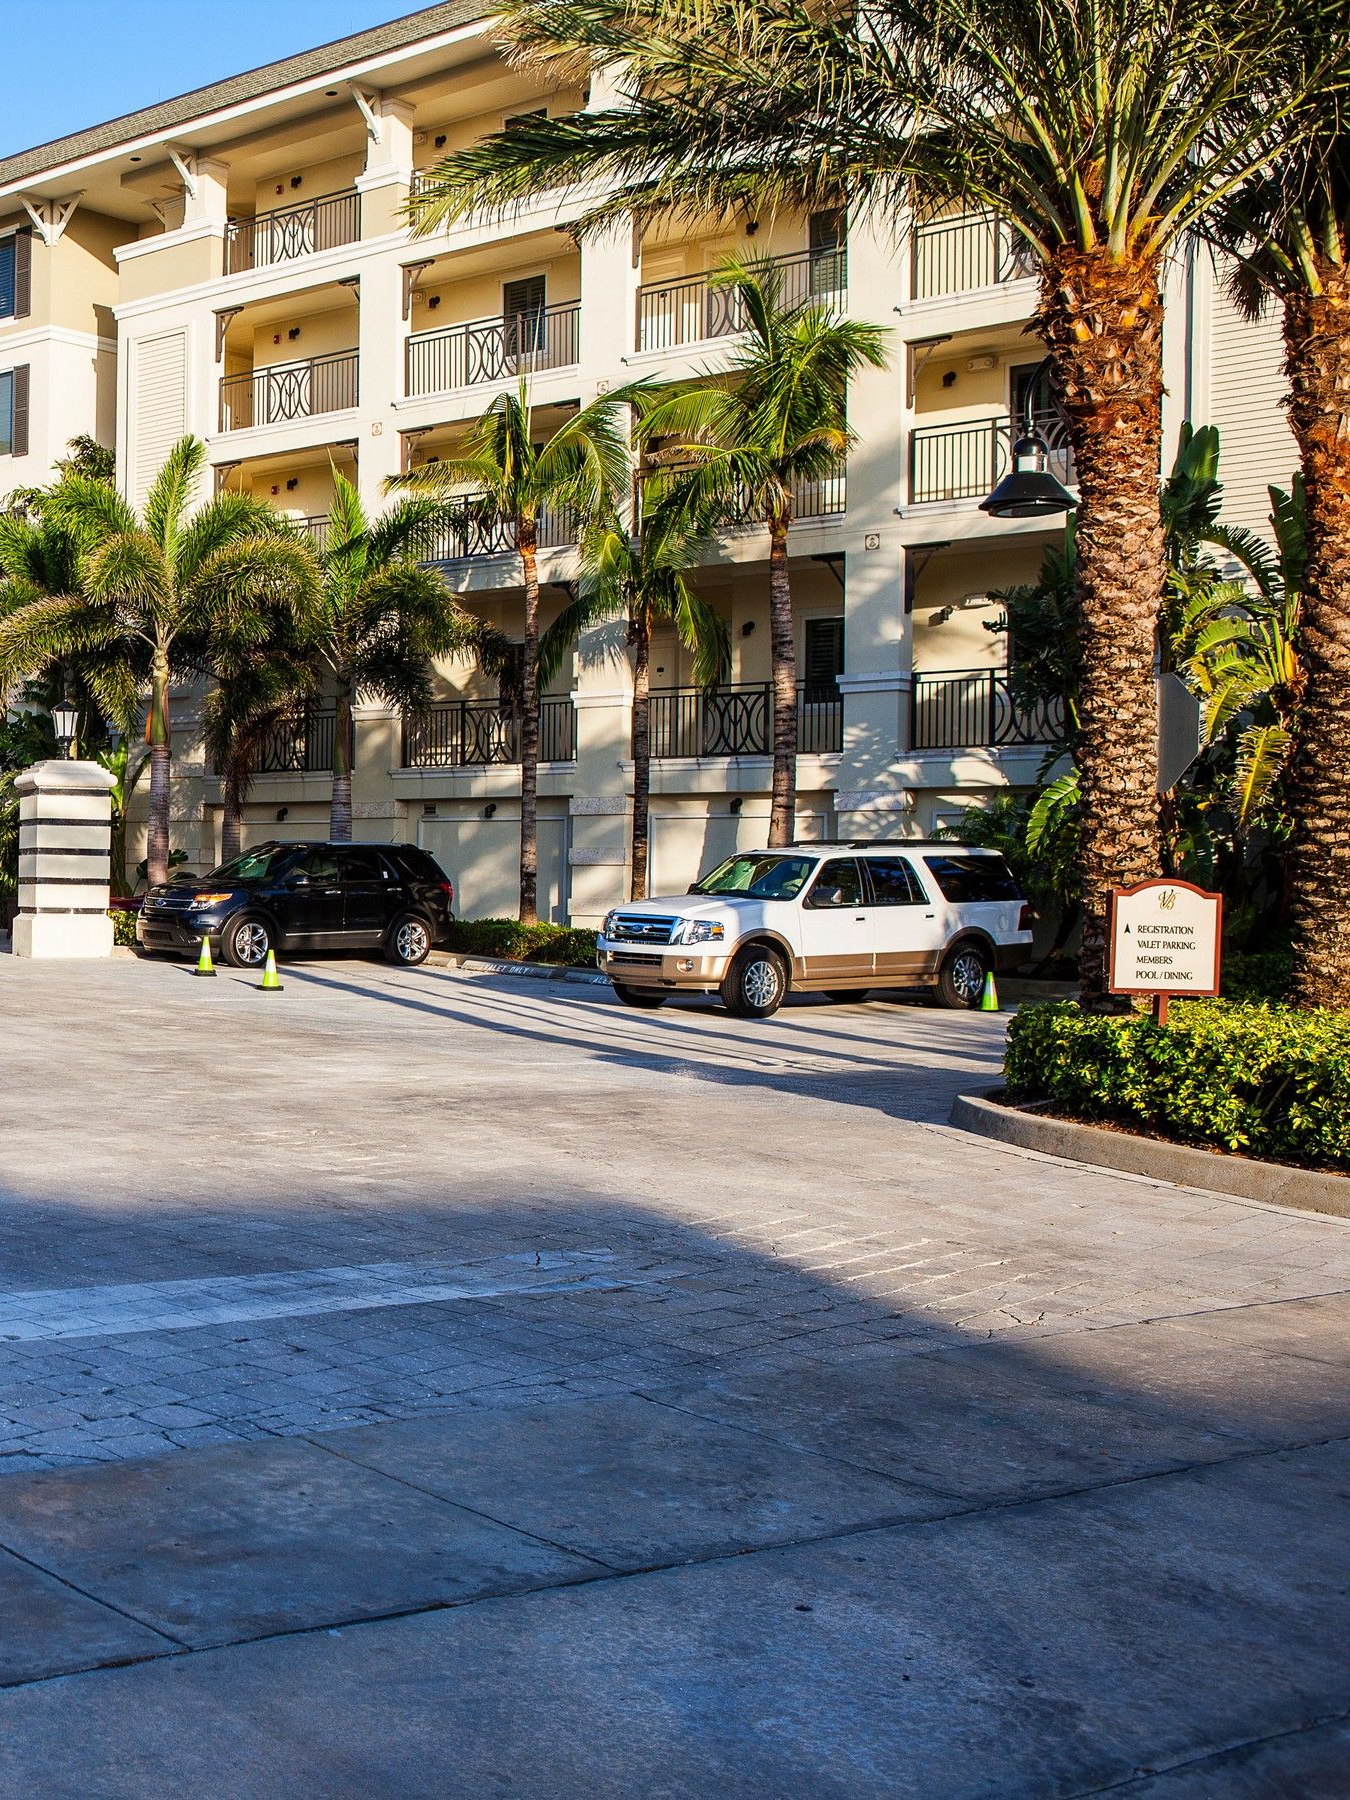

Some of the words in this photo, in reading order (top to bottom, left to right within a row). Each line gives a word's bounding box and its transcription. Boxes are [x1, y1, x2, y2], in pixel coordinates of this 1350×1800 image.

[1137, 924, 1194, 935] REGISTRATION
[1137, 940, 1162, 949] VALET
[1162, 941, 1196, 950] PARKING
[1136, 955, 1173, 965] MEMBERS
[1135, 970, 1159, 979] POOL
[1164, 971, 1193, 980] DINING
